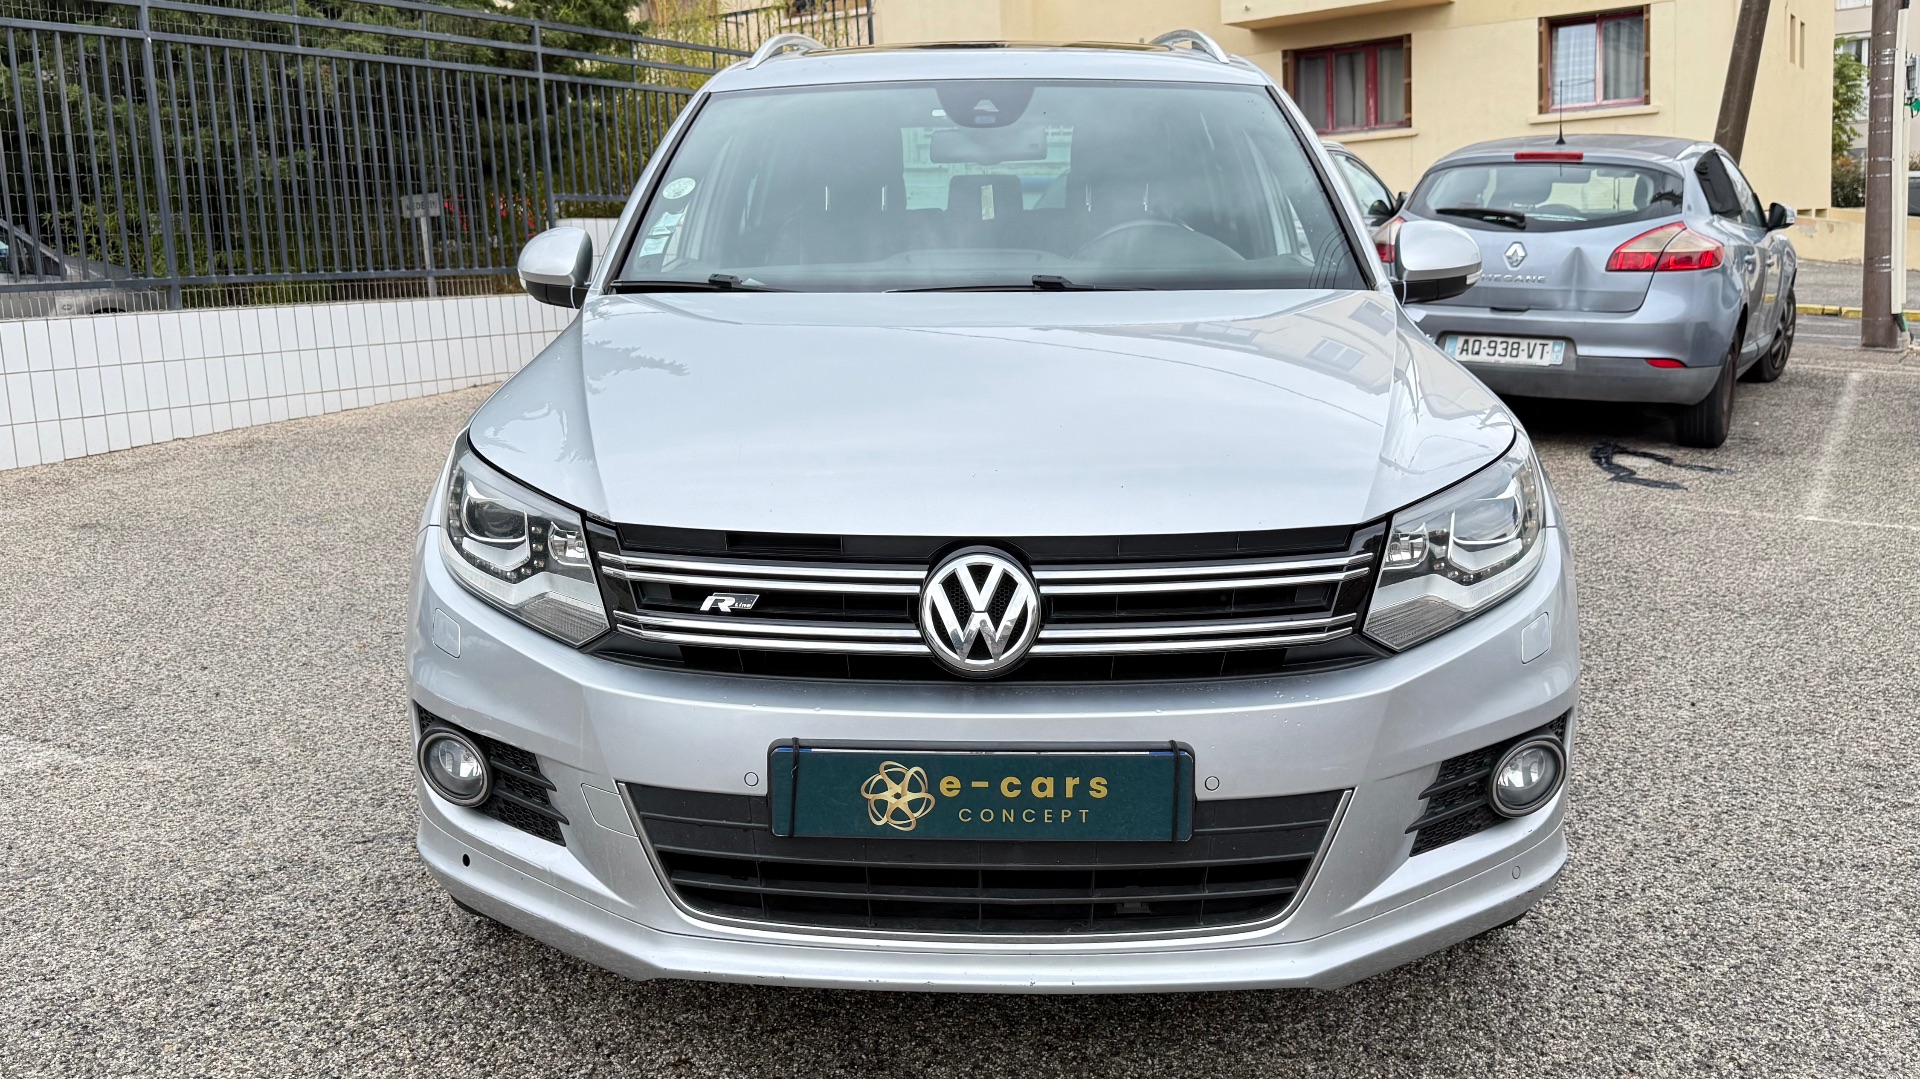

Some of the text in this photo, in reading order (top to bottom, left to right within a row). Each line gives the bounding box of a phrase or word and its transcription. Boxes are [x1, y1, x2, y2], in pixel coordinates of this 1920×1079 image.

[406, 200, 438, 211] MDEIN
[1459, 339, 1549, 360] AQ-938-VT
[939, 774, 1109, 799] e-cars
[958, 808, 1090, 823] CONCEPT
